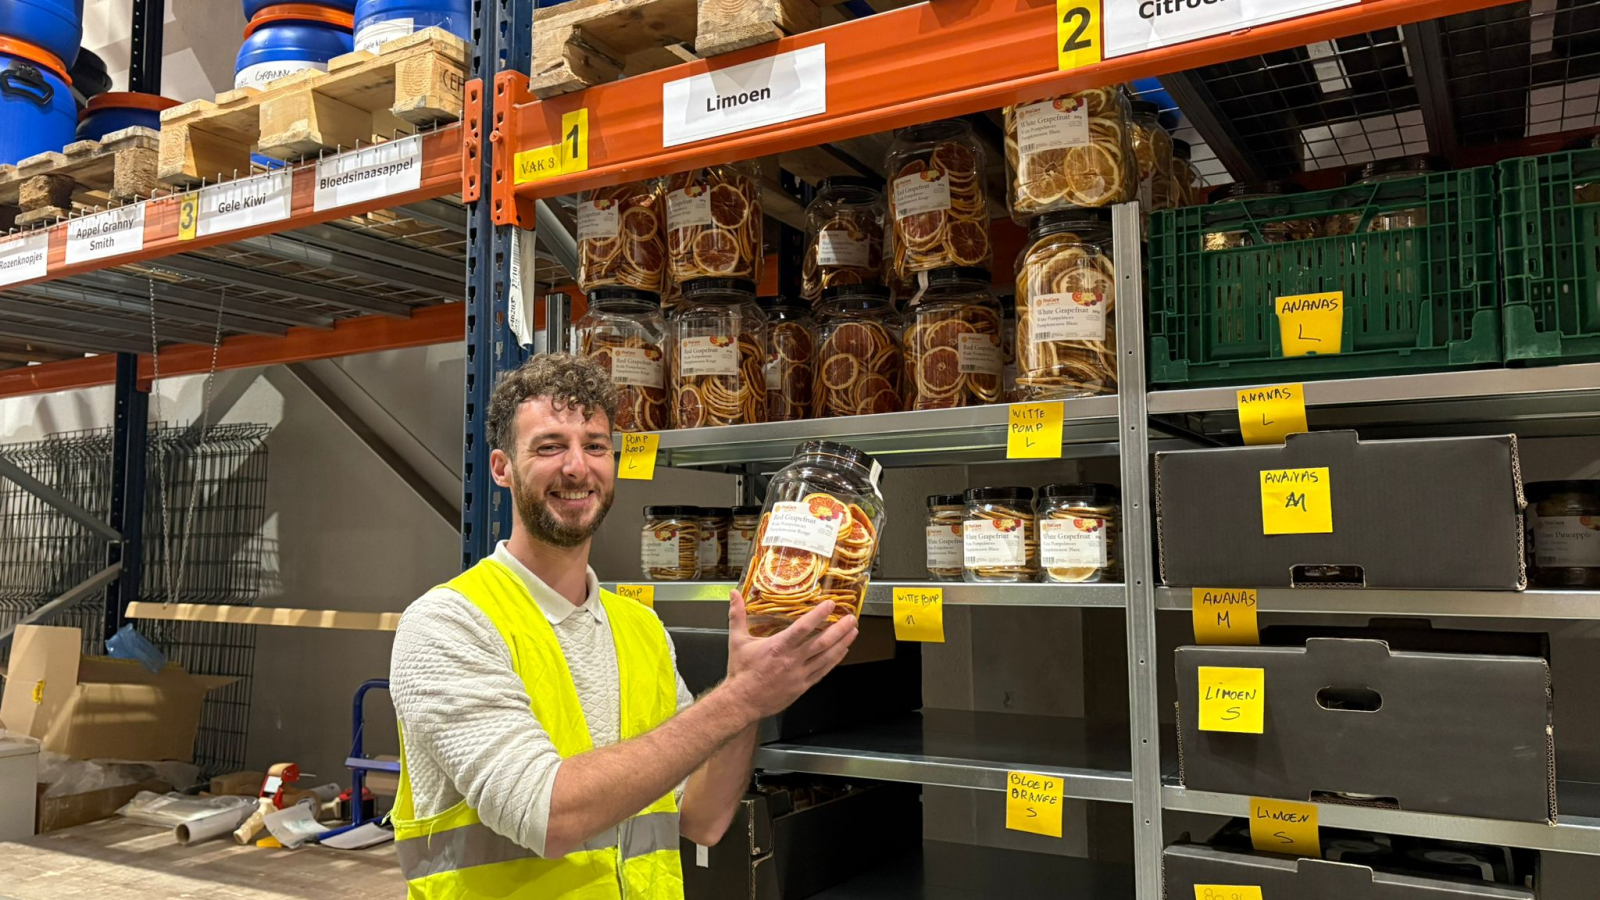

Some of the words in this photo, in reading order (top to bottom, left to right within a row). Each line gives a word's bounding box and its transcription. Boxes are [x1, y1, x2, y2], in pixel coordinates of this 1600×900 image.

[1062, 7, 1092, 52] 2
[706, 86, 771, 113] Limoen
[1037, 114, 1070, 124] Grapefruit
[566, 124, 580, 159] 1
[521, 158, 546, 175] VAK
[548, 157, 555, 169] 3
[320, 158, 413, 190] Bloedsinaasappel
[218, 198, 240, 214] Gele
[243, 193, 266, 208] Kiwi
[181, 202, 194, 230] 3
[76, 224, 100, 240] Appel
[102, 218, 134, 234] Granny
[89, 236, 114, 250] Smith
[0, 251, 43, 270] Rozenknopjes
[1036, 308, 1054, 316] White
[1054, 307, 1089, 315] Grapefruit
[1282, 298, 1338, 314] ANANAS
[1298, 324, 1322, 342] L
[693, 348, 718, 356] Grapefruit
[628, 358, 652, 366] Grapefruit
[1241, 388, 1291, 404] ANANAS
[1012, 406, 1045, 419] WITTE
[1262, 413, 1274, 426] L
[1012, 422, 1044, 434] POMP
[626, 434, 648, 444] POMP
[1026, 437, 1036, 448] L
[626, 444, 644, 454] ROOD
[628, 458, 637, 470] L
[1264, 470, 1318, 484] ANANAS
[784, 513, 817, 524] Grapefruit
[938, 538, 962, 546] Grapefru
[1058, 533, 1090, 541] Grapefruit
[619, 586, 642, 597] POMP
[1202, 591, 1256, 606] ANANAS
[897, 592, 920, 604] WITTE
[922, 594, 940, 606] POMP
[1218, 610, 1230, 628] M
[1220, 706, 1241, 720] S
[1026, 807, 1038, 818] S
[1257, 806, 1310, 822] LIMOEN
[1273, 832, 1294, 844] S
